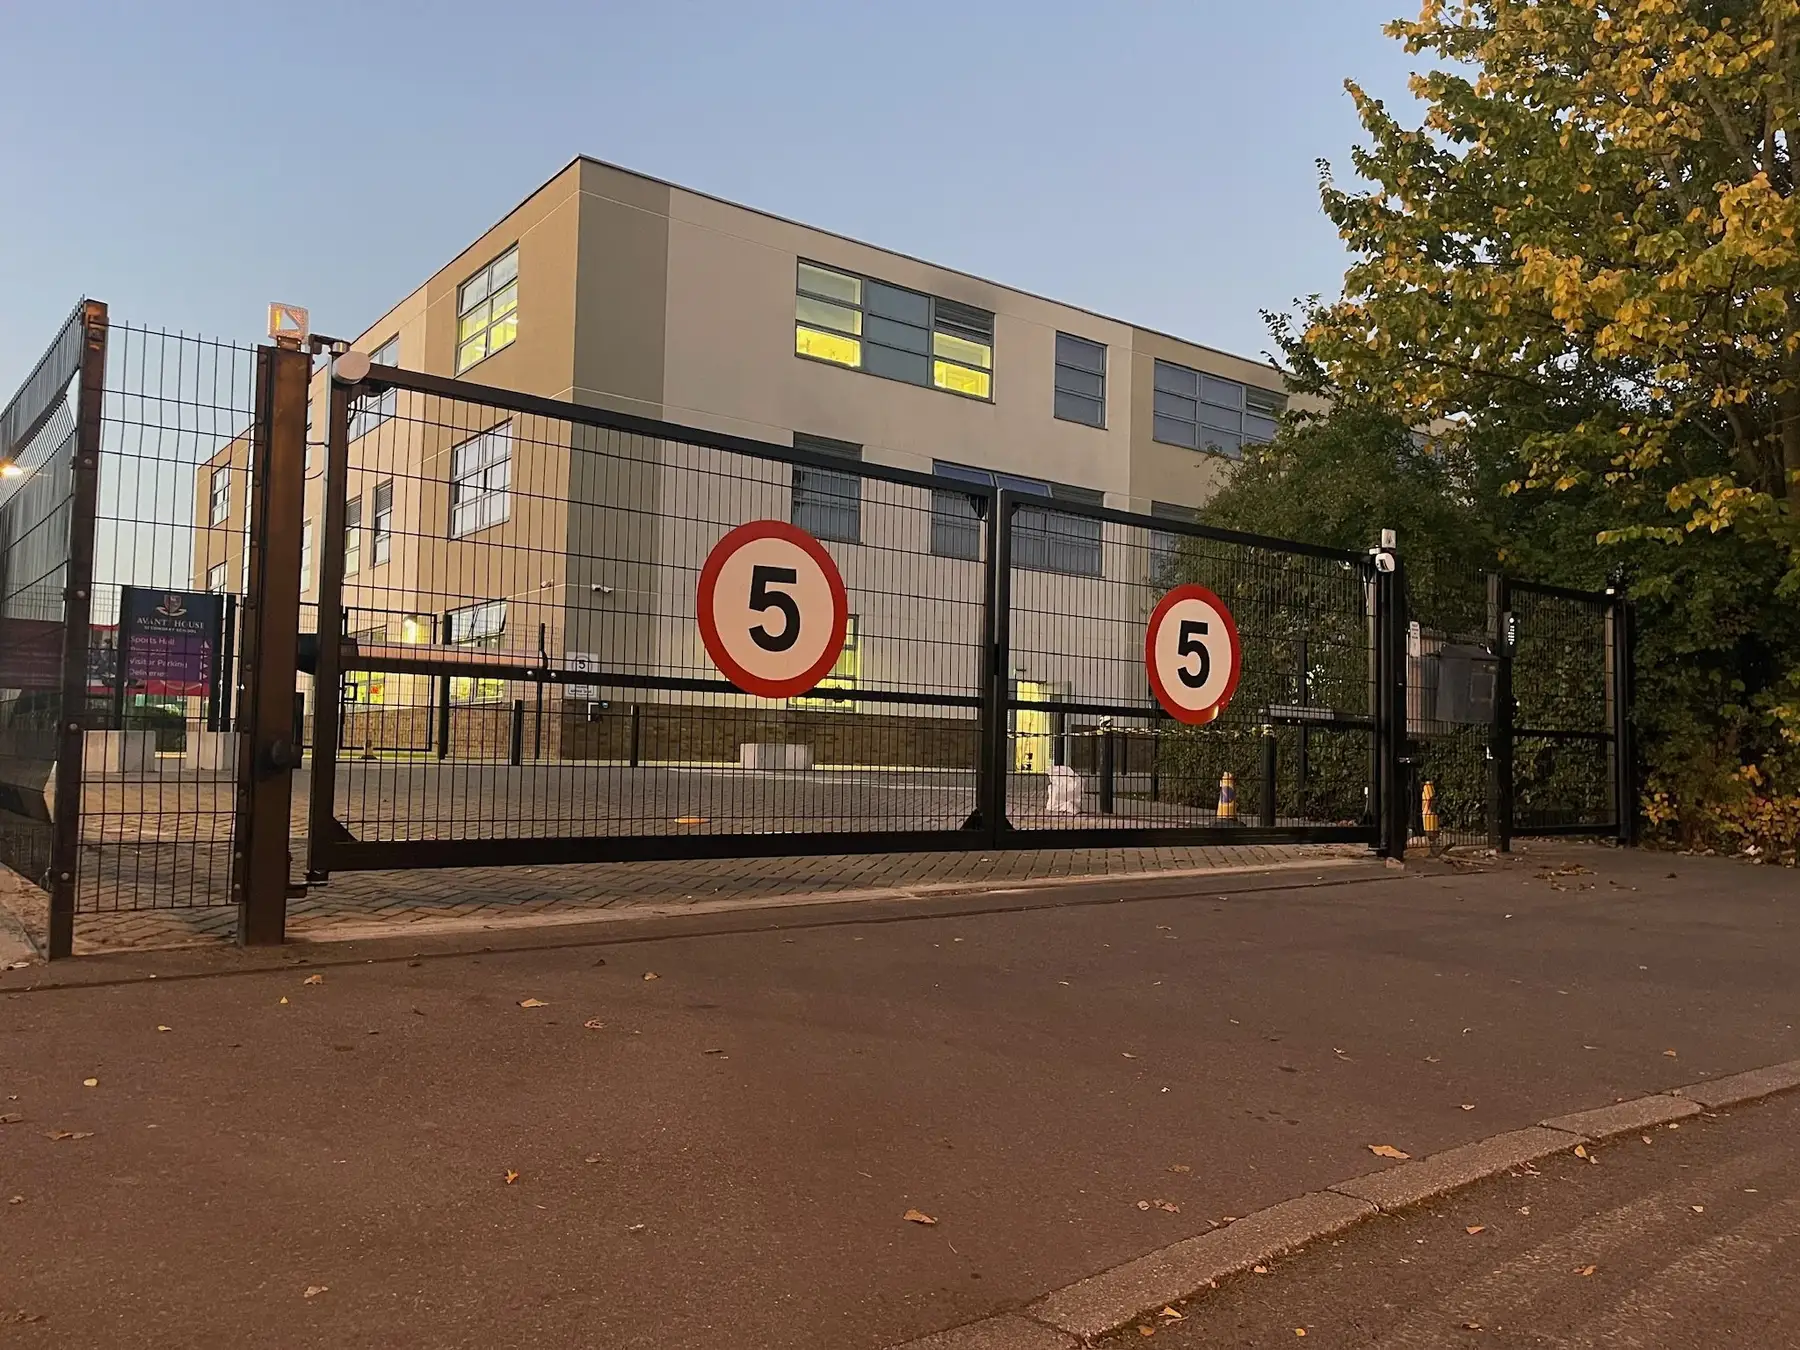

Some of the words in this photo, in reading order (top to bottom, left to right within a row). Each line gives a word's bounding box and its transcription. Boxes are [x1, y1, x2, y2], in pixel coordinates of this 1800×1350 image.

[137, 617, 172, 626] AVANT
[748, 565, 801, 652] 5
[130, 635, 157, 645] Sports
[1177, 620, 1210, 689] 5
